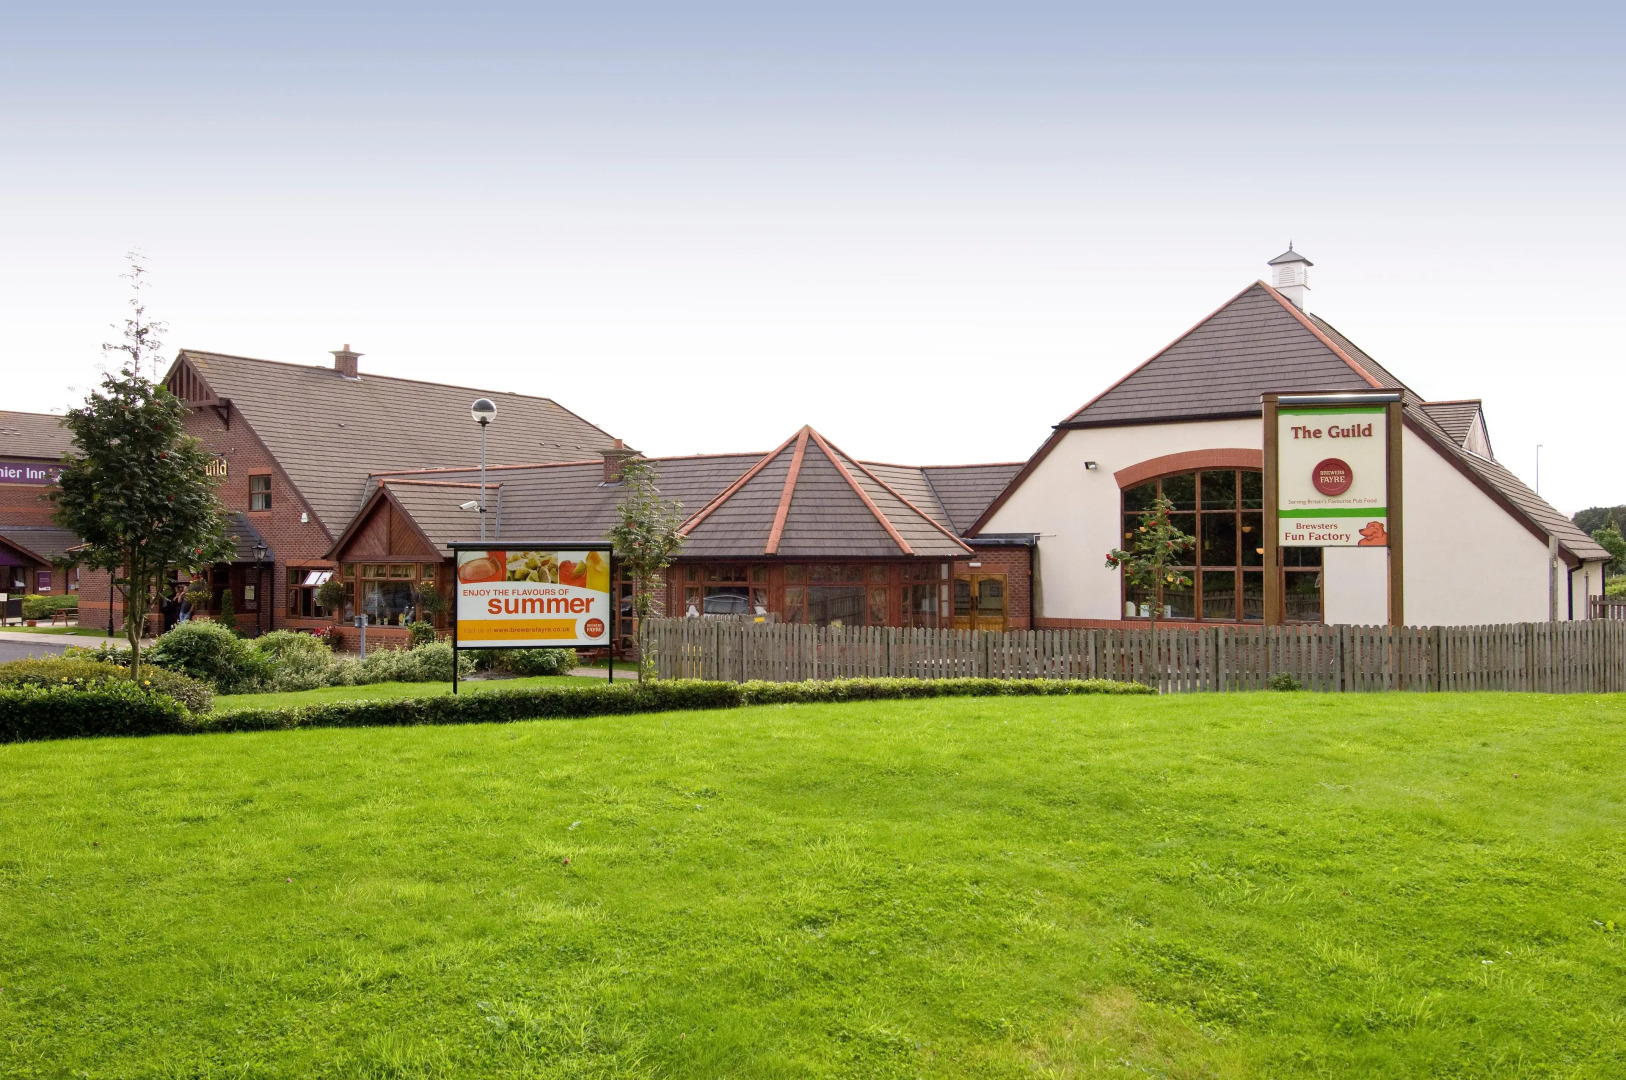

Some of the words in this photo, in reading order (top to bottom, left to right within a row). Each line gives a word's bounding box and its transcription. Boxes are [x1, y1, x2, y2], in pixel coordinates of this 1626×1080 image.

[1291, 425, 1322, 439] The
[1328, 423, 1372, 438] Guild
[26, 467, 46, 479] Inn
[204, 460, 228, 476] uild
[1285, 532, 1305, 541] Fun
[1309, 532, 1351, 542] Factory
[487, 597, 595, 615] summer
